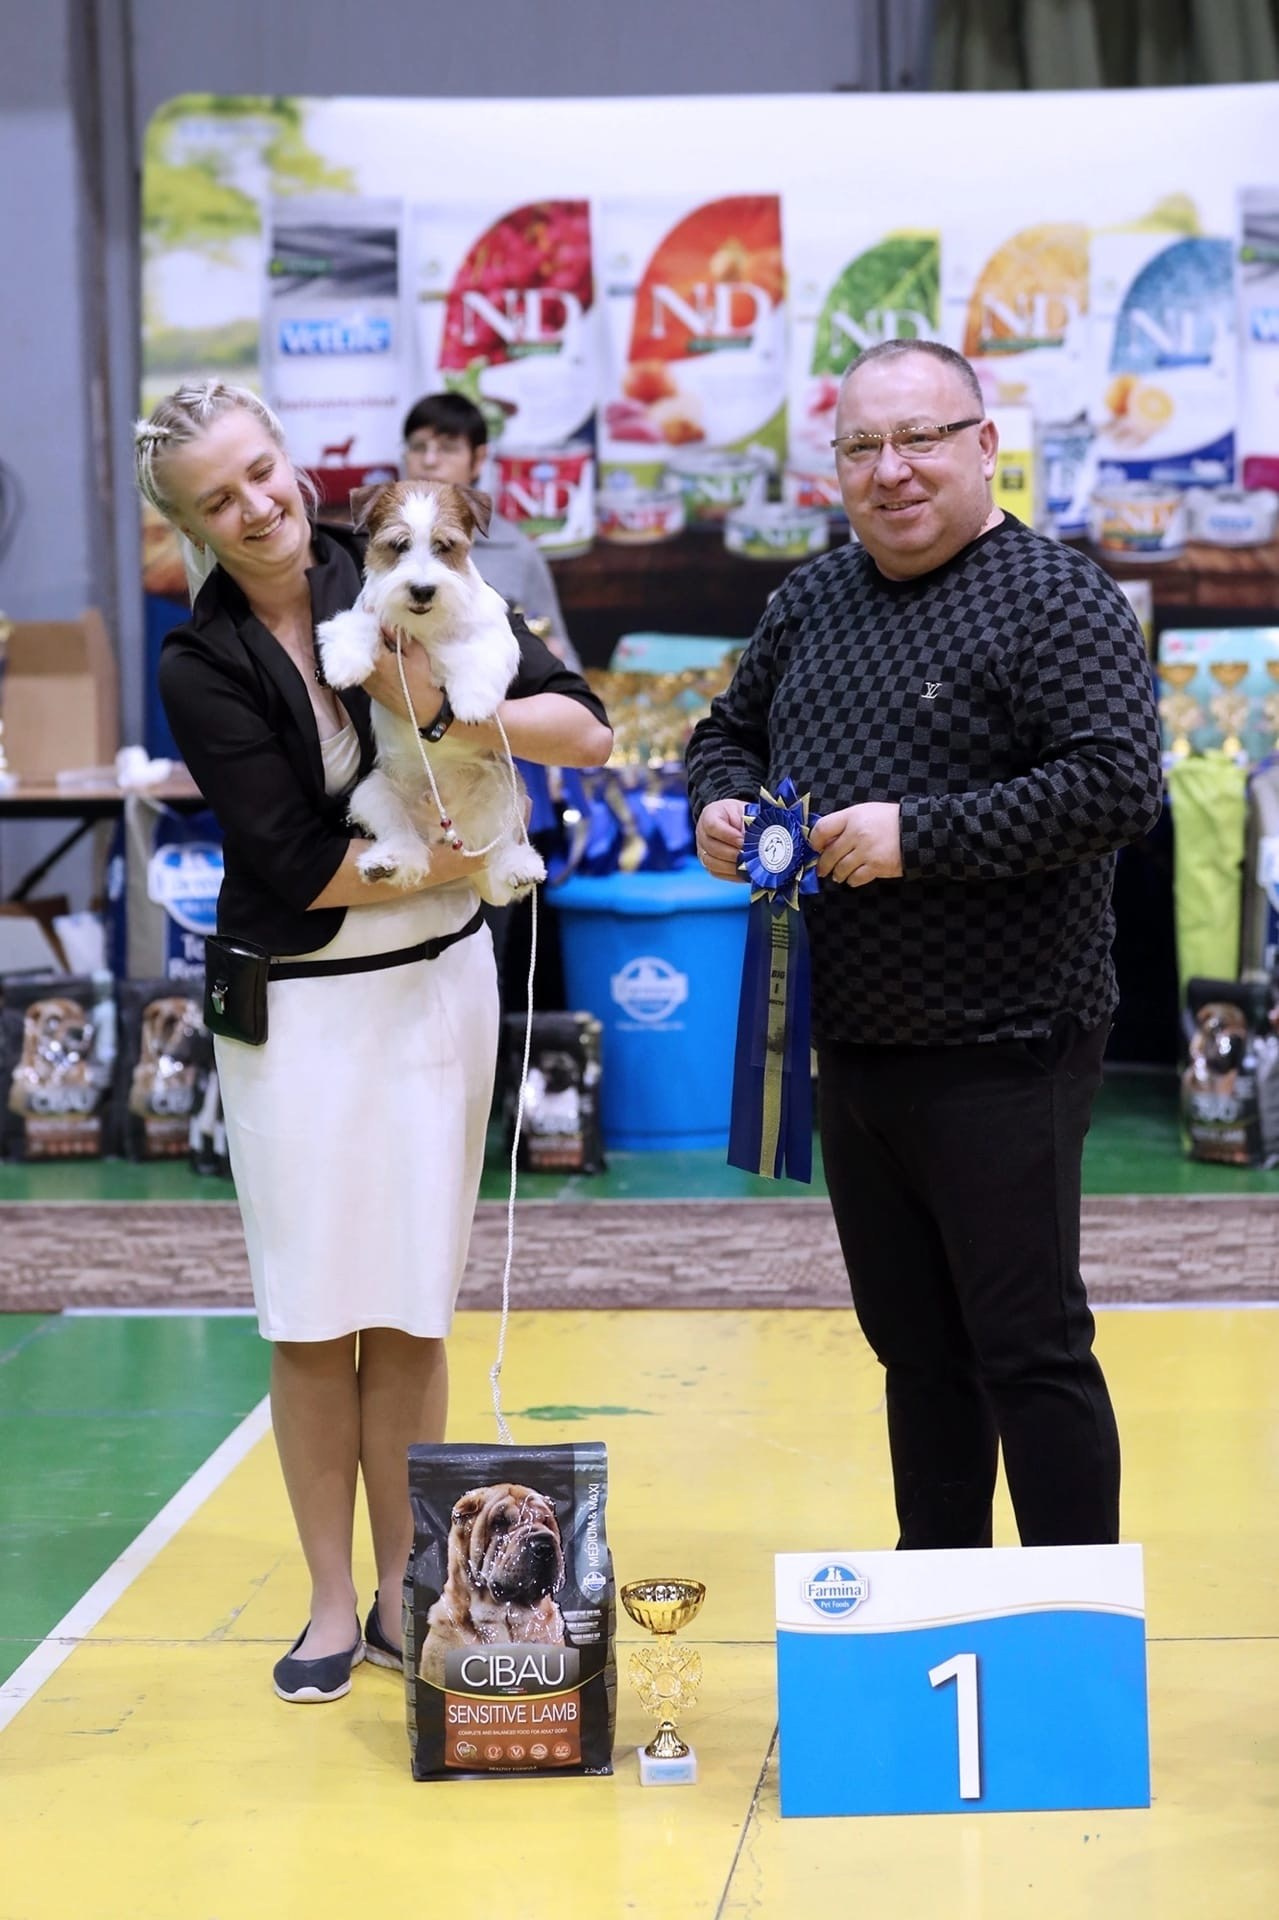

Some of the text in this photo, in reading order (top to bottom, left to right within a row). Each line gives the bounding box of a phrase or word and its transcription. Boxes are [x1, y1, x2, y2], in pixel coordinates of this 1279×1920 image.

[588, 1483, 600, 1511] MAXI
[587, 1521, 600, 1567] MEDIUM
[808, 1583, 862, 1597] Farmina
[832, 1600, 850, 1608] Foods
[461, 1654, 565, 1687] CIBAU
[448, 1702, 578, 1724] SENSITIVE LAMB
[928, 1653, 981, 1800] 1
